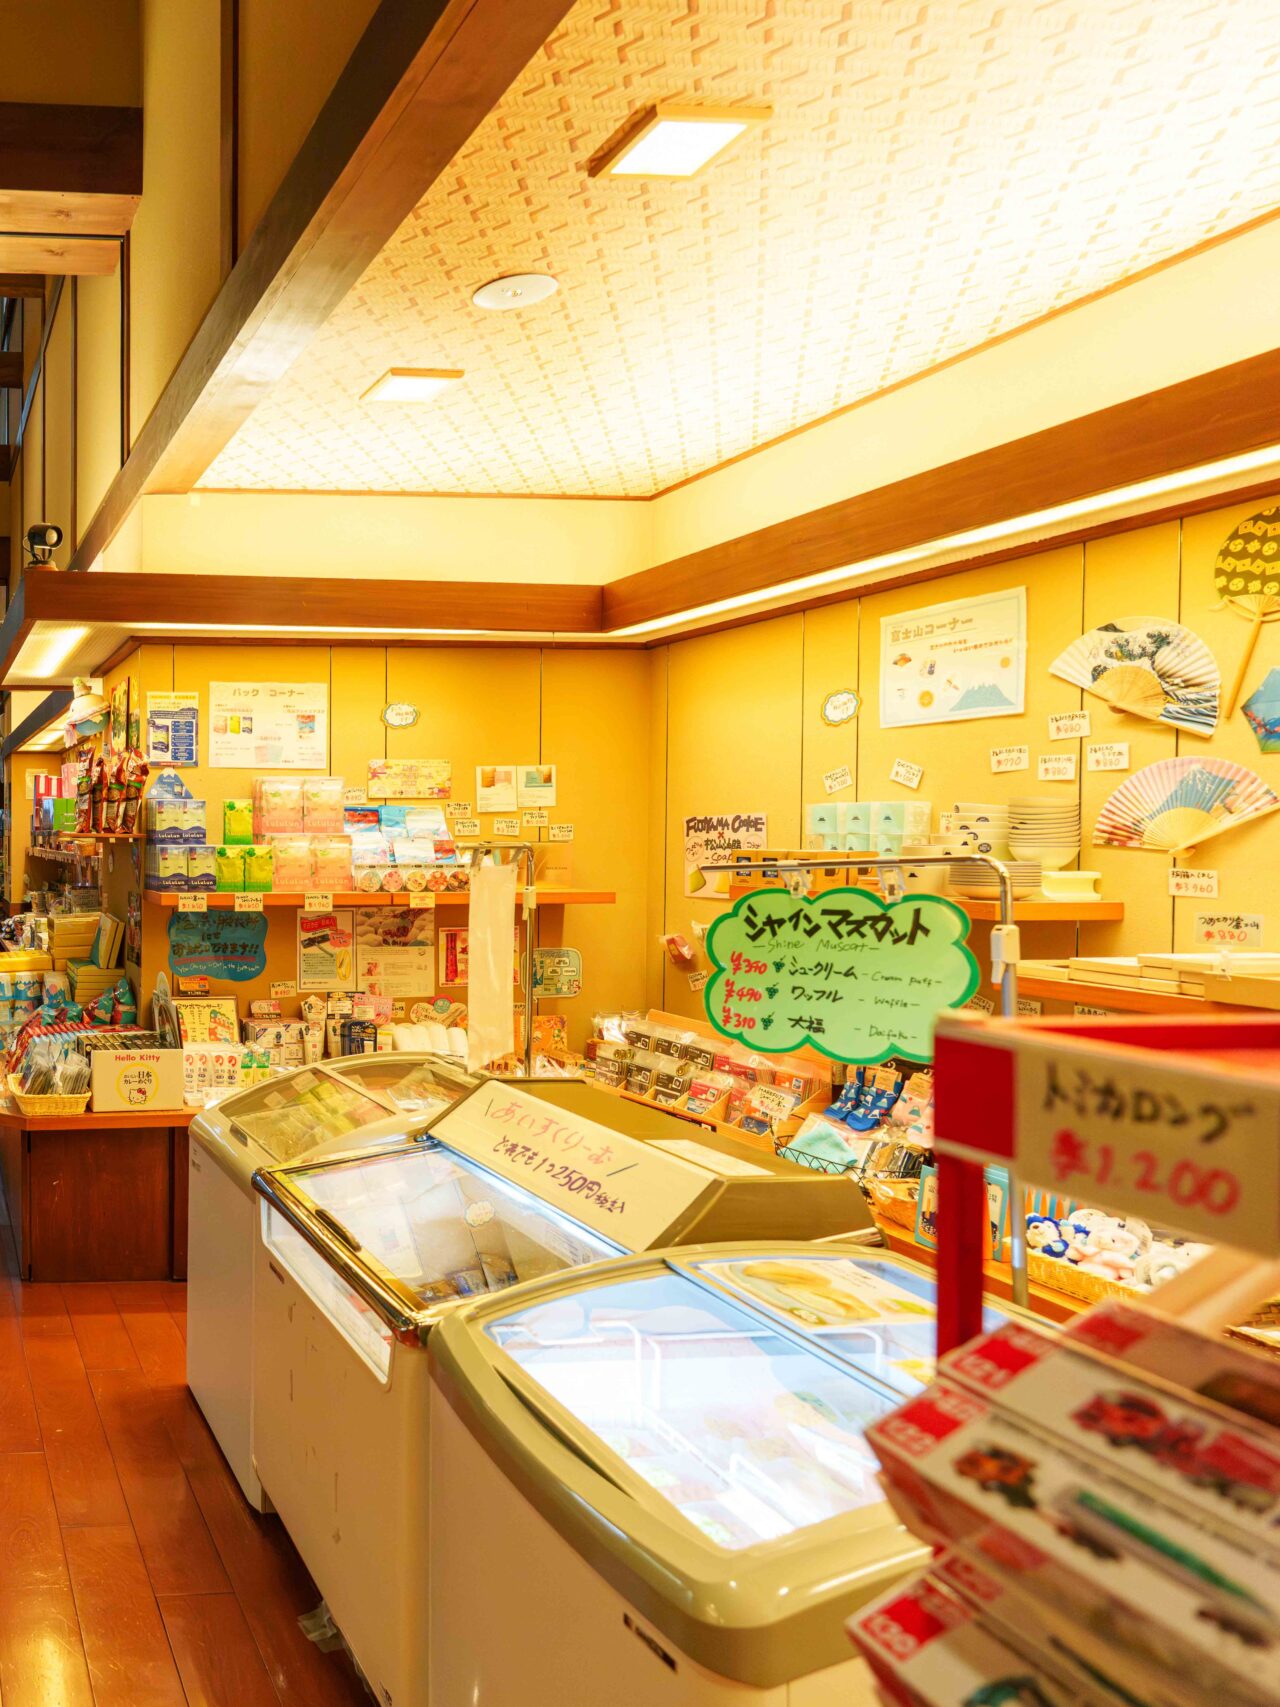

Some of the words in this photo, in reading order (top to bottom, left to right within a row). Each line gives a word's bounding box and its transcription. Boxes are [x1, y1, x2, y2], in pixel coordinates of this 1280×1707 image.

[891, 617, 974, 643] 富士山コーナー
[269, 688, 305, 698] コーナー
[743, 904, 931, 946] シャインマスカット
[767, 938, 805, 953] Shine
[788, 955, 859, 980] シュークリーム
[791, 986, 844, 1003] ワッフル
[787, 1016, 826, 1034] 大福
[140, 1054, 160, 1063] Kitty
[1042, 1058, 1257, 1147] トミカロング
[490, 1100, 615, 1165] あいすくりーむ
